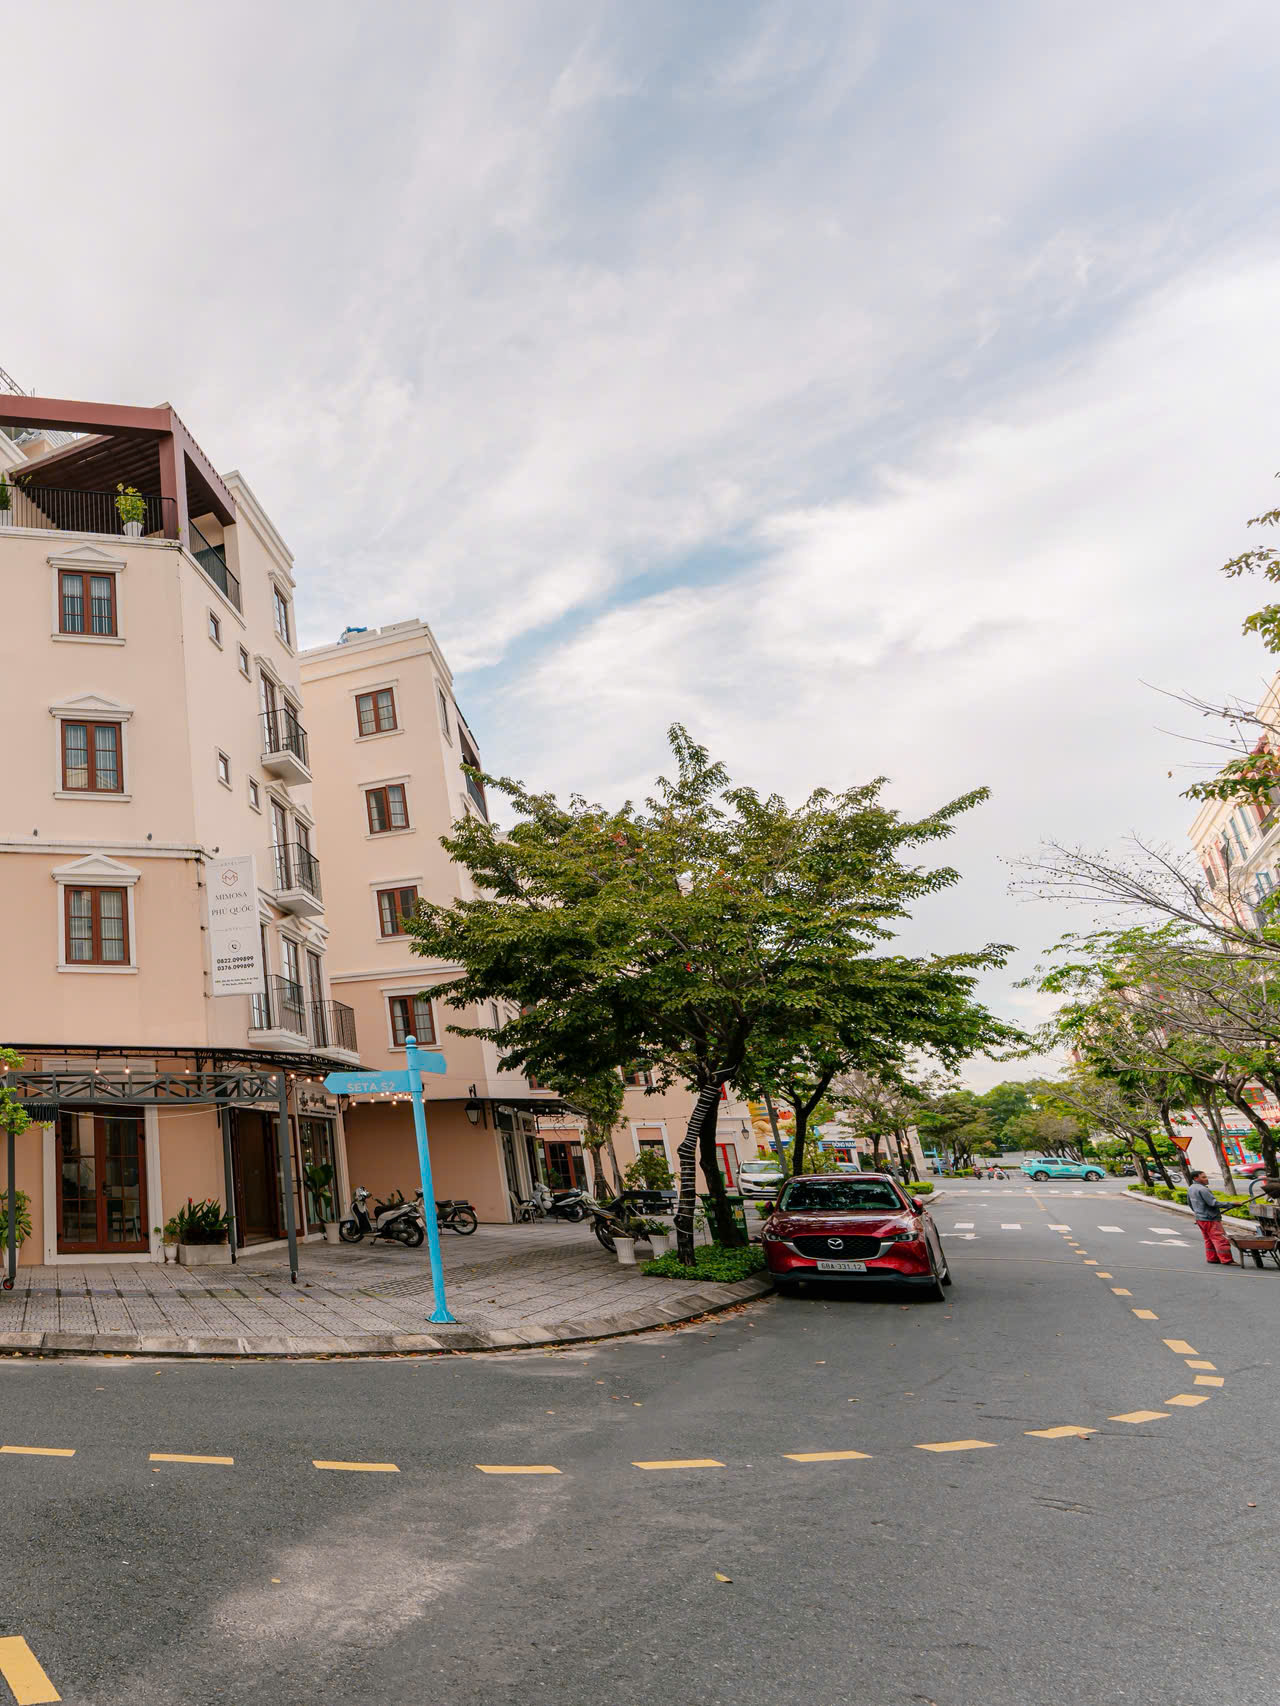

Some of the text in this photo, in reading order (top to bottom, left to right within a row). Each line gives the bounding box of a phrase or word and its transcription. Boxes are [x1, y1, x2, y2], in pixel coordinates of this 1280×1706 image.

[215, 891, 248, 901] MIMOSA
[229, 903, 254, 915] QUỐC
[346, 1081, 396, 1092] SETA S2
